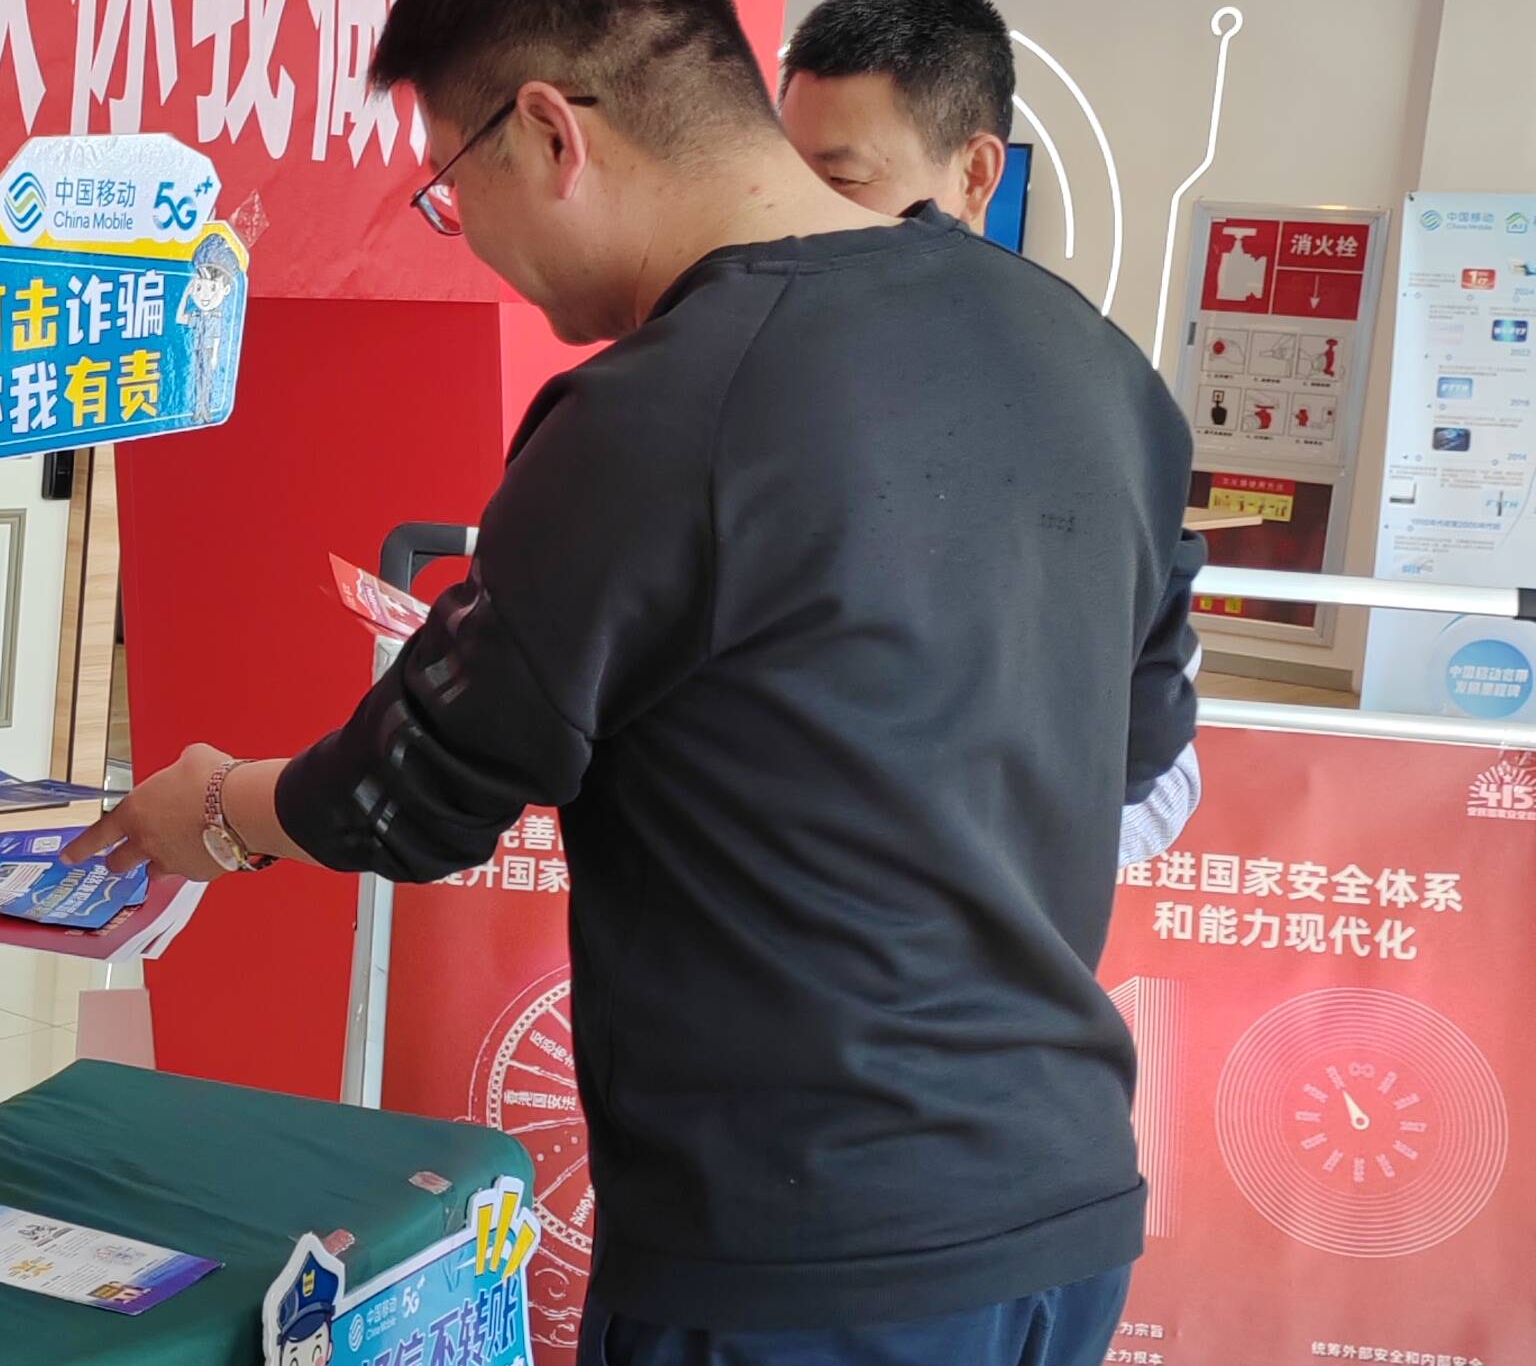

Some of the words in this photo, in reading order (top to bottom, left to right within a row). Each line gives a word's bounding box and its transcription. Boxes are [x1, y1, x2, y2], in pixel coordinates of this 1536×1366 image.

[55, 176, 137, 208] 中国移动
[53, 210, 90, 229] China
[92, 212, 134, 230] Mobile
[1290, 233, 1359, 258] 消火栓
[1152, 900, 1418, 960] 和能力现代化
[1115, 1321, 1164, 1339] 为宗旨
